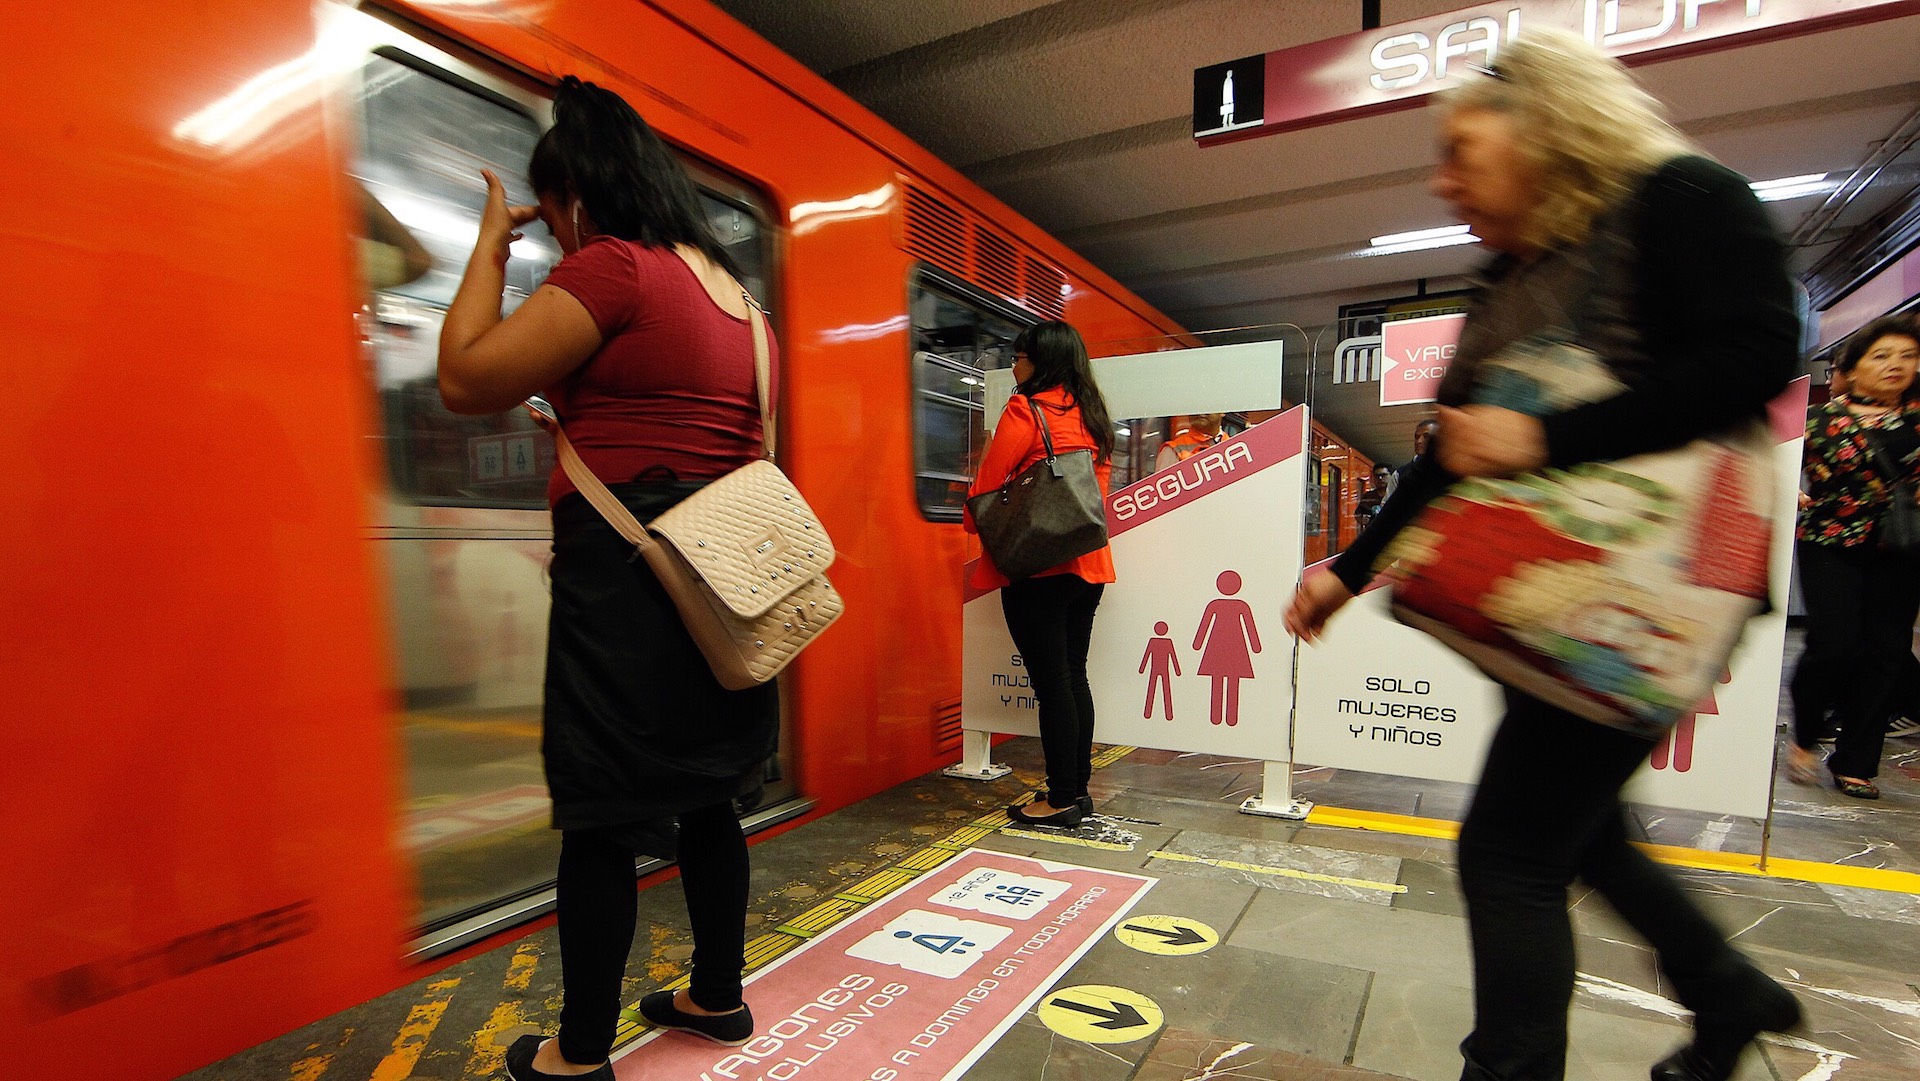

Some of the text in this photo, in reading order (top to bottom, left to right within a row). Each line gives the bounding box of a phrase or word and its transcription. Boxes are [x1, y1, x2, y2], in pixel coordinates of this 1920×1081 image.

[1112, 441, 1254, 521] SEGURA
[1365, 676, 1431, 695] SOLO
[1000, 694, 1012, 707] Y
[1338, 698, 1457, 723] MUJERES
[1349, 724, 1442, 747] Y NIÑOS
[891, 1049, 921, 1066] A
[909, 978, 1000, 1049] DOMINGO
[992, 957, 1025, 978] EN
[1013, 925, 1061, 956] TODO
[1050, 885, 1108, 926] HORARIO
[756, 982, 910, 1081] CLUSIVOS
